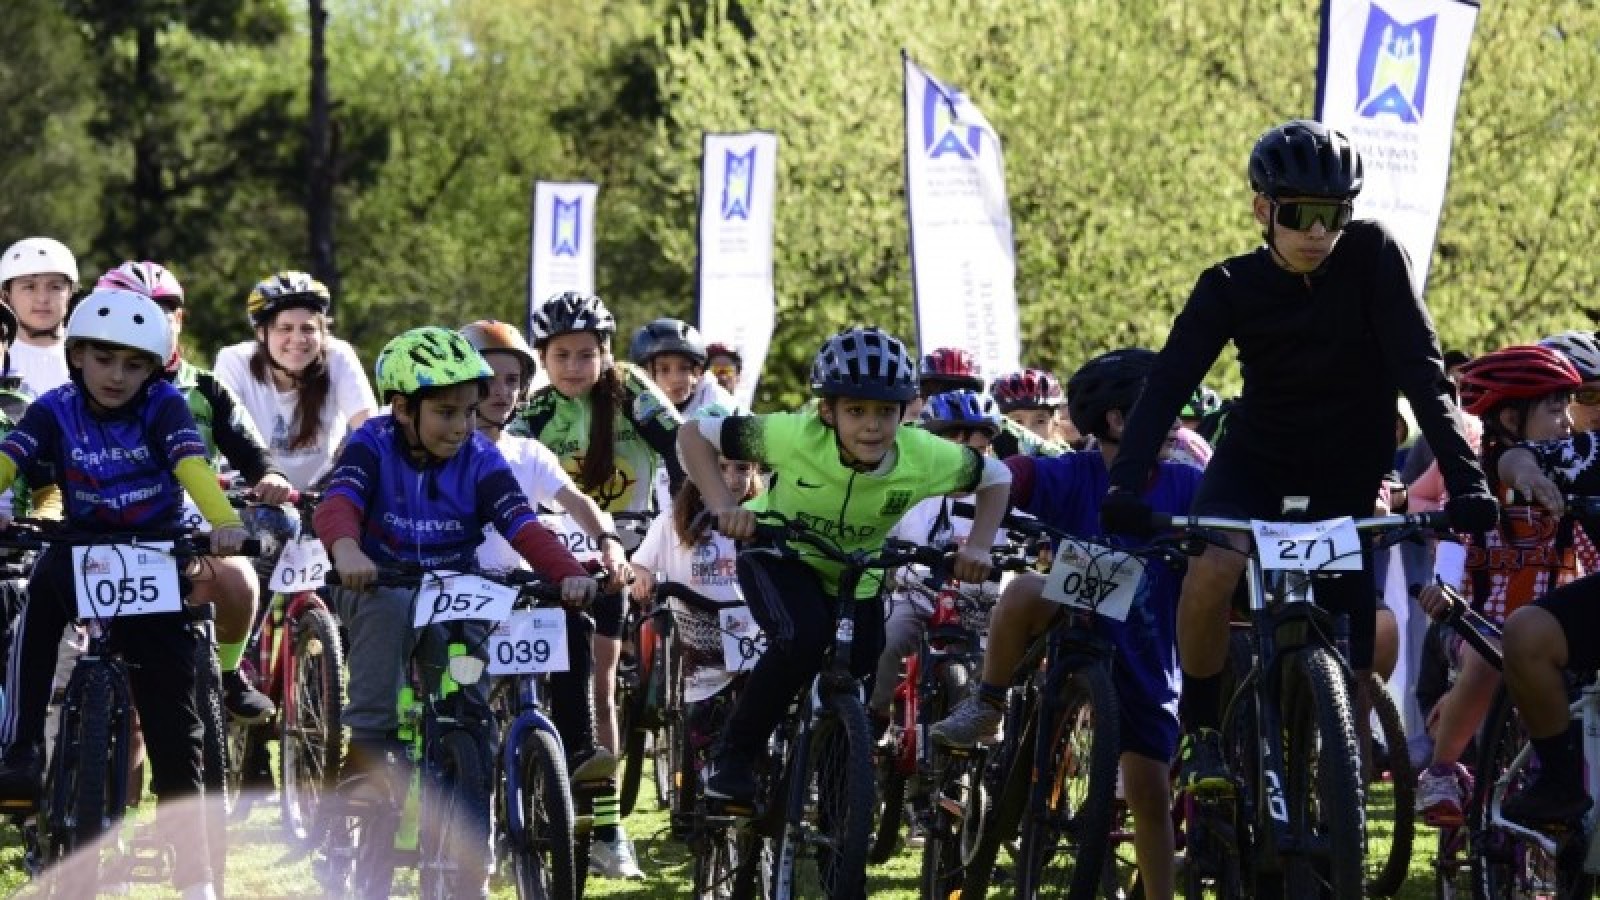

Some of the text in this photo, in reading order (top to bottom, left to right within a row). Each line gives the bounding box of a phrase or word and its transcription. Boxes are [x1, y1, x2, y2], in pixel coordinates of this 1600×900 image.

[1278, 538, 1336, 561] 271
[281, 562, 324, 587] 012
[96, 576, 160, 606] 055
[433, 593, 495, 615] 057
[496, 639, 551, 666] 039
[738, 634, 769, 661] 03
